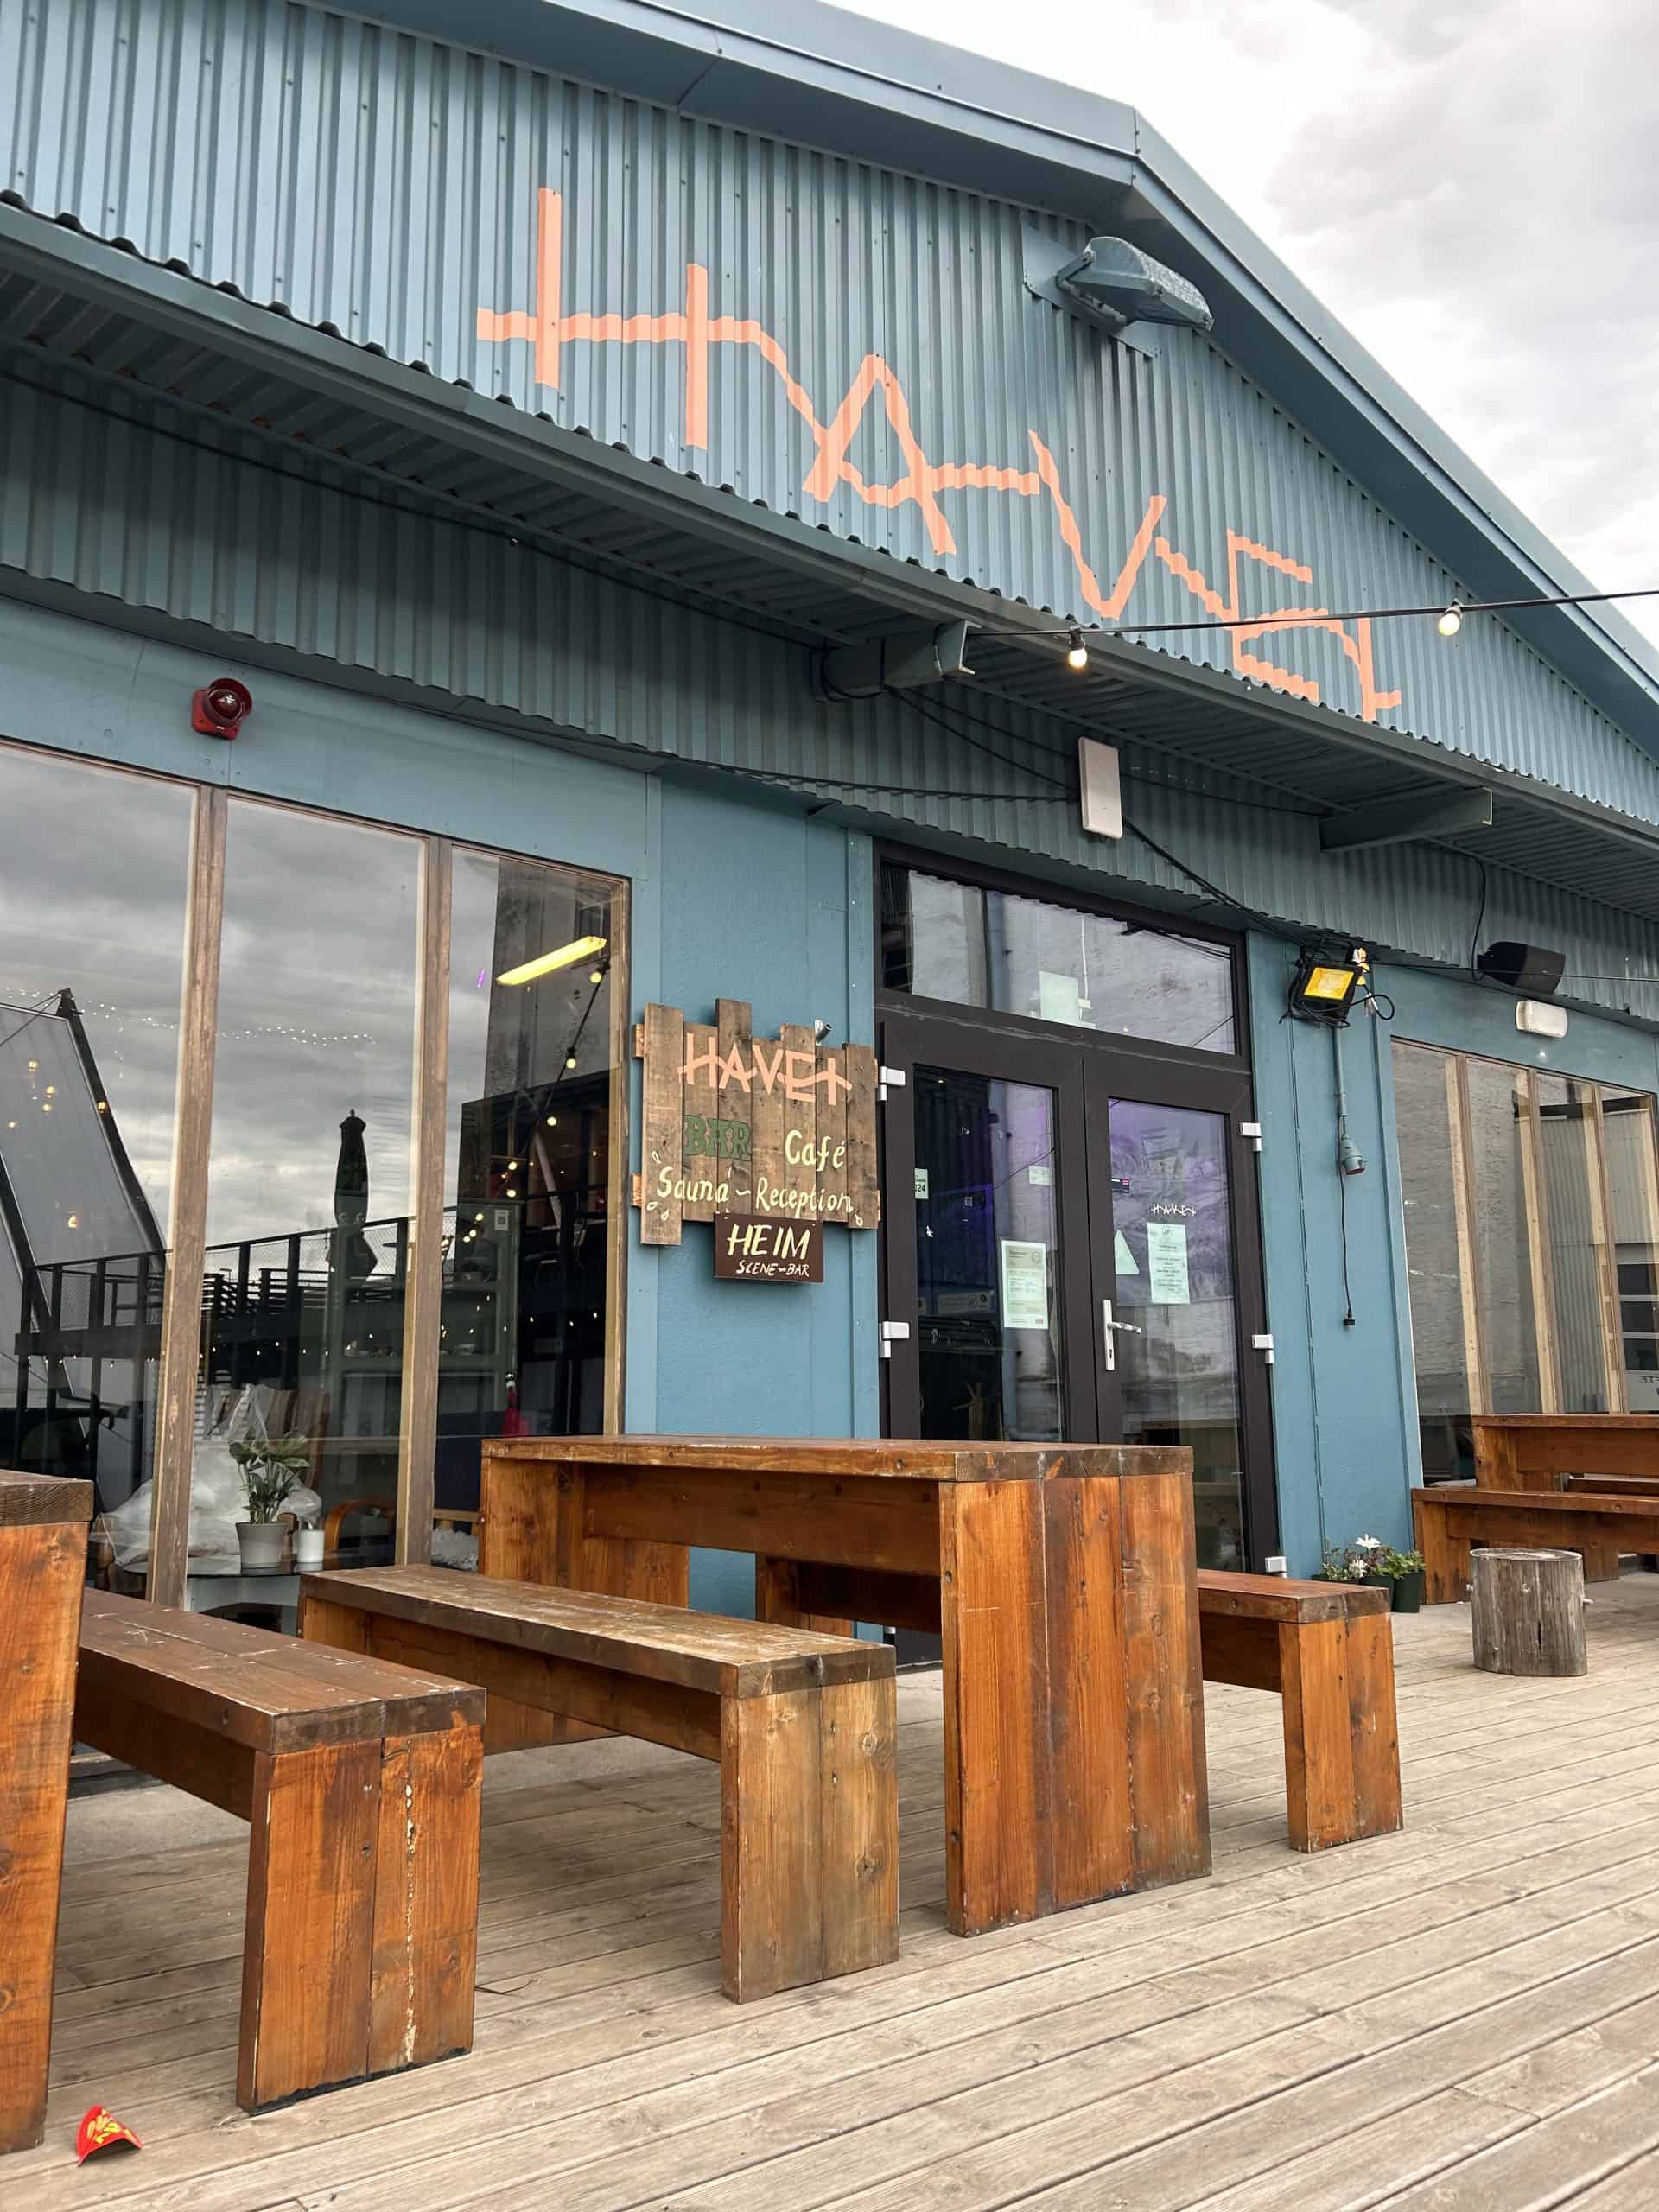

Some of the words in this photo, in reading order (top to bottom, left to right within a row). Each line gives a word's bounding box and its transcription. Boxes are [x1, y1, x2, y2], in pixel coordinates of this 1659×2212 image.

[477, 187, 1402, 722] HAVET
[677, 1033, 853, 1106] HAVET
[683, 1115, 753, 1162] BAR
[785, 1129, 847, 1172] Café
[656, 1166, 730, 1204] Sauna
[755, 1176, 854, 1219] Reception
[726, 1223, 811, 1260] HEIM
